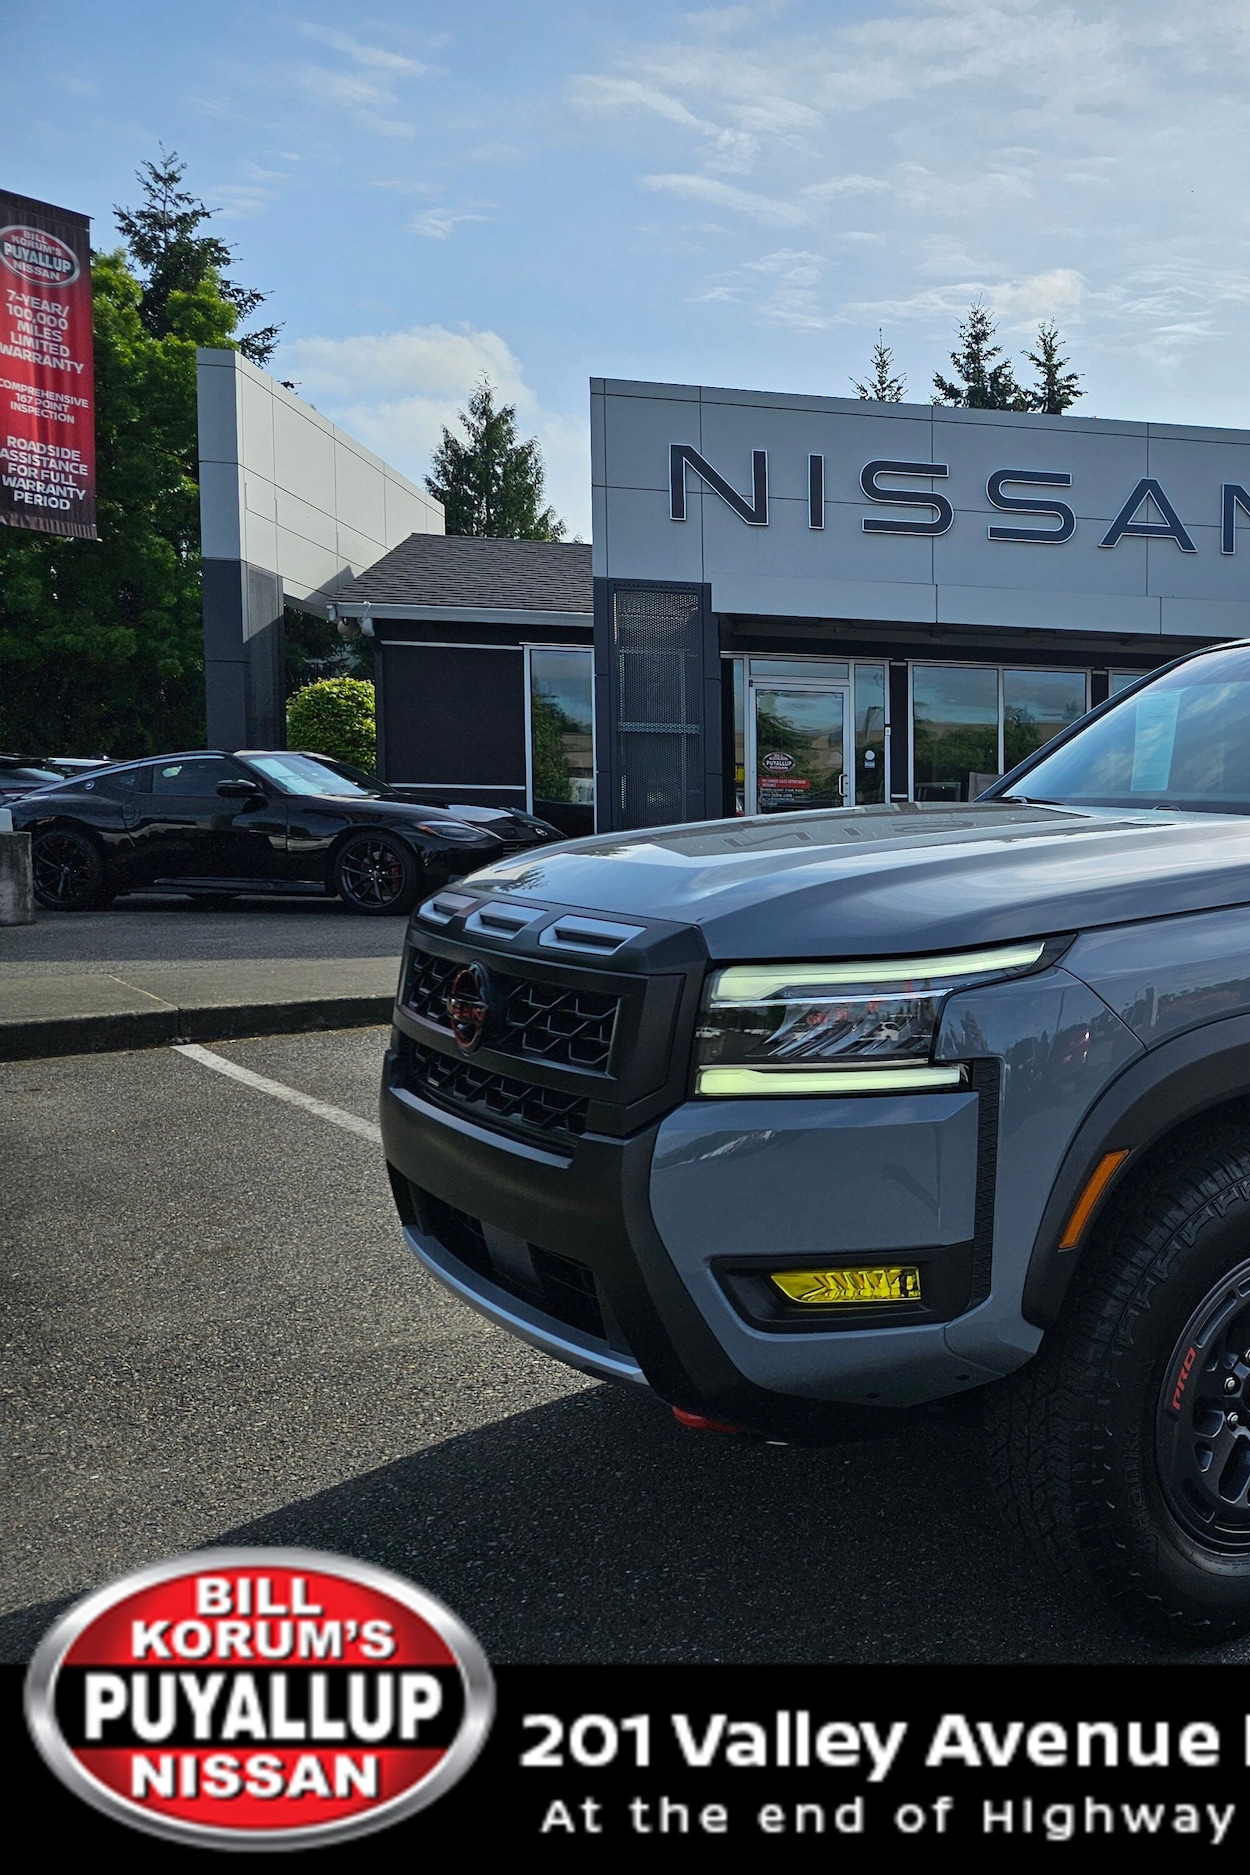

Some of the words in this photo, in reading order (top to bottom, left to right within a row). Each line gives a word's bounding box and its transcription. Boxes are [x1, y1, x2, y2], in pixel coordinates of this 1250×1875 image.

[11, 235, 62, 256] KORUM'S
[23, 230, 48, 245] BILL
[4, 241, 72, 274] PUYALLUP
[13, 259, 61, 282] NISSAN
[6, 288, 70, 318] 7-YEAR/
[6, 303, 69, 331] 100,000
[10, 331, 70, 358] LIMITED
[17, 319, 63, 343] MILES
[0, 342, 84, 375] WARRANTY
[0, 378, 89, 409] COMPREHENSIVE
[15, 392, 33, 405] 167
[34, 396, 69, 413] POINT
[10, 401, 75, 425] INSPECTION
[0, 447, 89, 476] ASSISTANCE
[6, 435, 81, 462] ROADSIDE
[2, 474, 86, 501] WARRANTY
[7, 462, 38, 480] FOR
[40, 468, 77, 487] FULL
[13, 489, 71, 511] PERIOD
[1172, 1346, 1197, 1411] PRO
